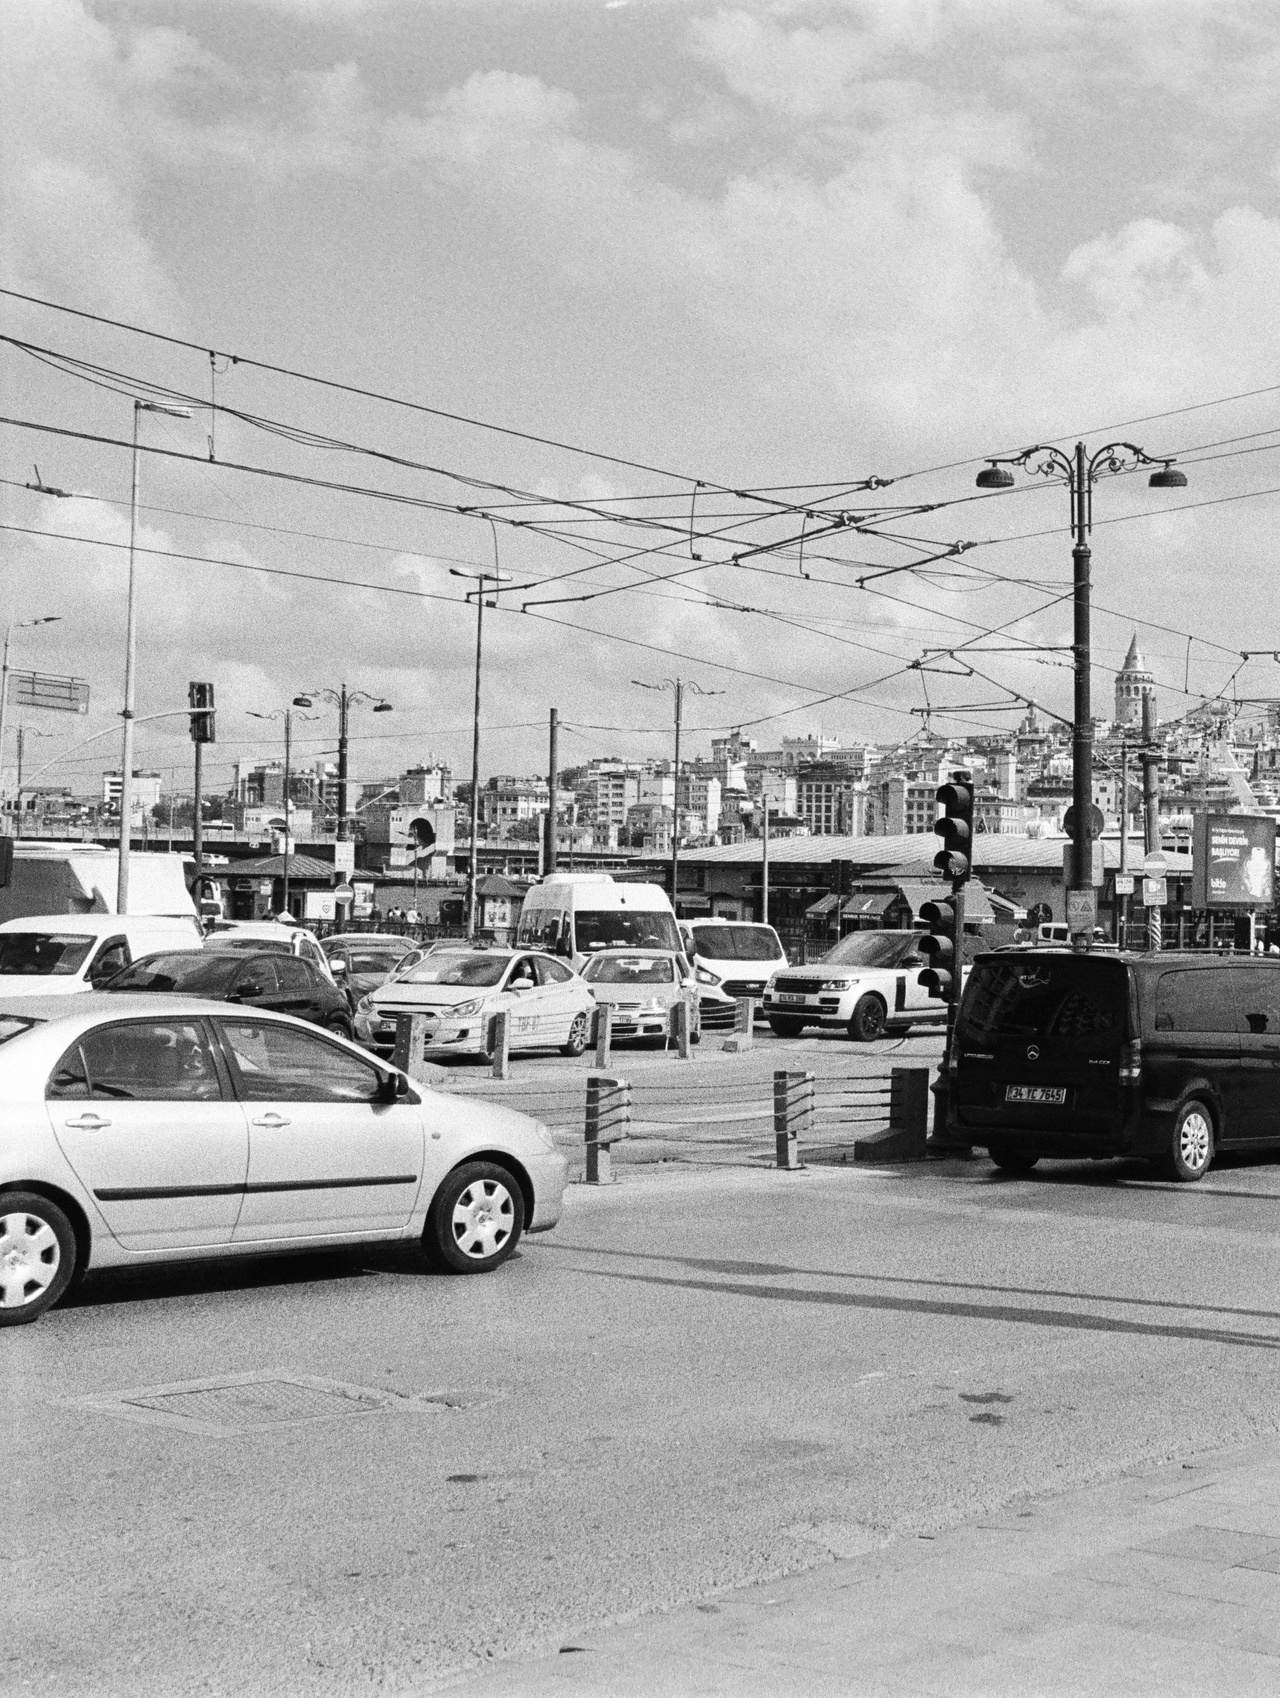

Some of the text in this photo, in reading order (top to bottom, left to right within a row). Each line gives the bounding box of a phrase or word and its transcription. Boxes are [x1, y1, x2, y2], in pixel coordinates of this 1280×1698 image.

[1012, 1087, 1062, 1100] 34 YC 7645
